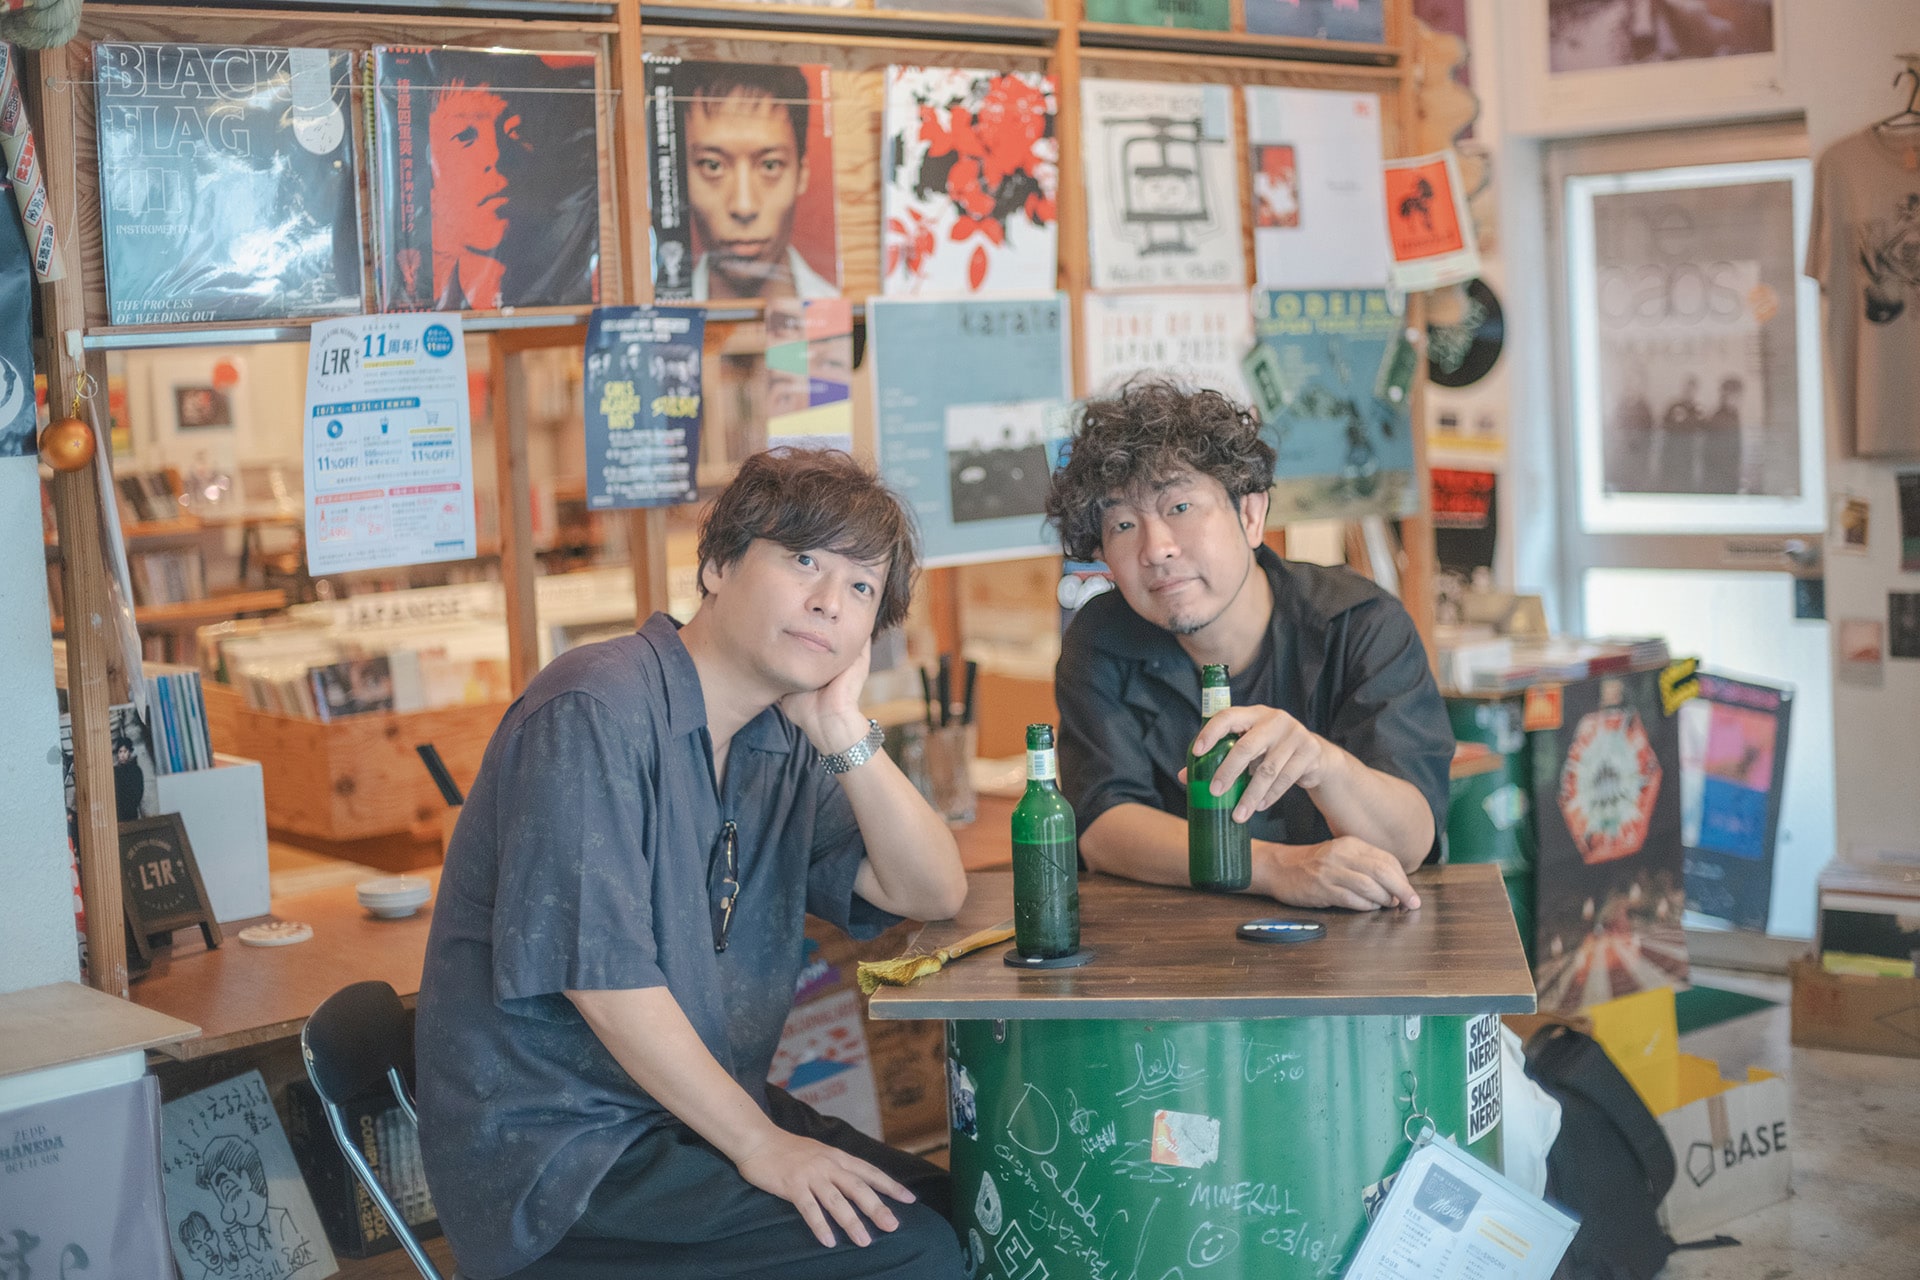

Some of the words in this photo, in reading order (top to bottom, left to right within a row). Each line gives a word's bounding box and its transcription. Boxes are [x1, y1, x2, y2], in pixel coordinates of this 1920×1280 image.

[104, 44, 294, 100] BLACK
[107, 105, 250, 158] FLAG
[116, 300, 140, 311] THE
[142, 298, 194, 310] PROCESS
[116, 312, 133, 323] OF
[135, 311, 190, 323] WEEDING
[192, 310, 216, 322] OUT
[1258, 291, 1396, 318] ODEIN
[1470, 1014, 1498, 1049] SKATE
[1469, 1036, 1498, 1075] NERDS
[1471, 1069, 1498, 1112] SKATE
[1470, 1098, 1499, 1137] NERDS
[1, 1135, 65, 1162] HANEDA
[14, 1125, 46, 1143] ZEPP
[1724, 1121, 1787, 1168] BASE
[5, 1160, 25, 1175] OCT
[41, 1152, 60, 1166] SUN
[1189, 1181, 1302, 1216] MINERAL
[1428, 1198, 1465, 1220] Menu
[1381, 1254, 1399, 1270] SOUR
